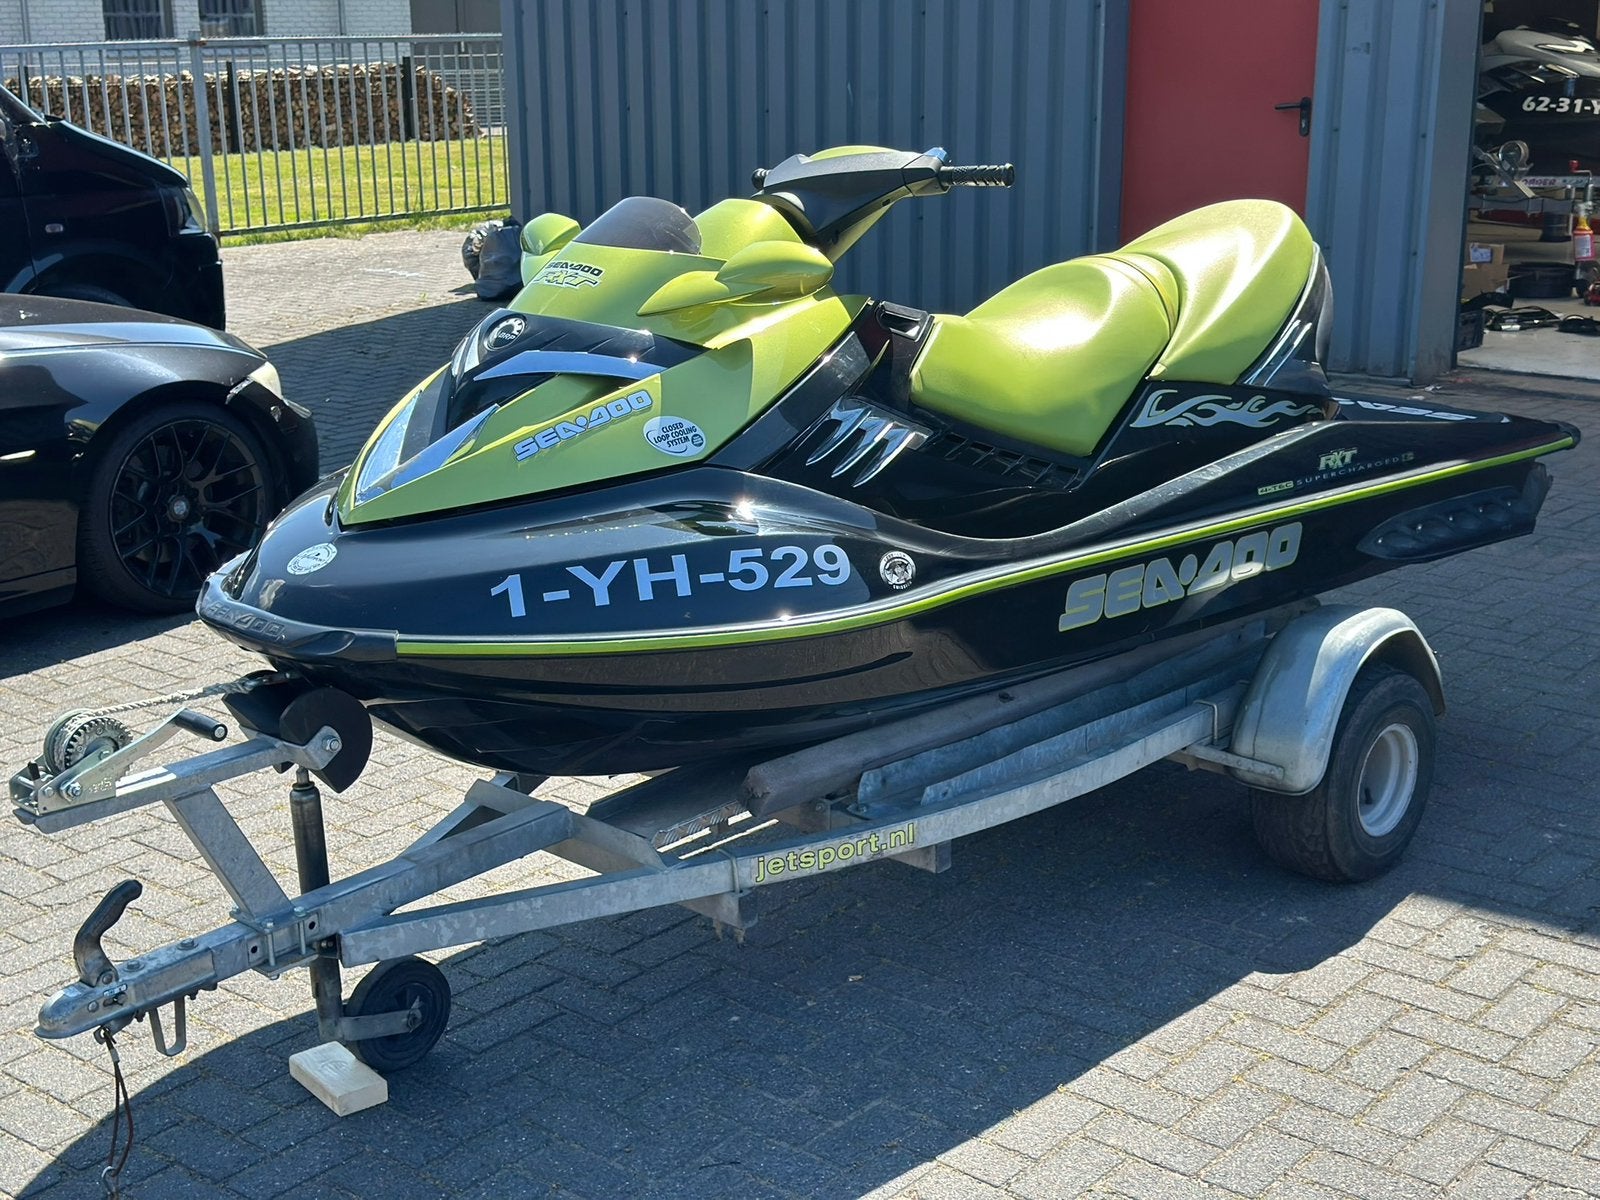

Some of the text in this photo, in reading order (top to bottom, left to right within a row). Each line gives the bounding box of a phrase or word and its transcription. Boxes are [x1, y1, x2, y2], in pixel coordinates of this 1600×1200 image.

[653, 425, 697, 444] LOOP COOLING
[661, 421, 684, 434] CLOSED
[666, 435, 691, 448] SYSTEM
[1296, 456, 1399, 486] SUPERCHARGED
[1318, 447, 1358, 471] RXT
[490, 544, 851, 618] 1-YH-529
[756, 823, 915, 882] jetsport.nl
